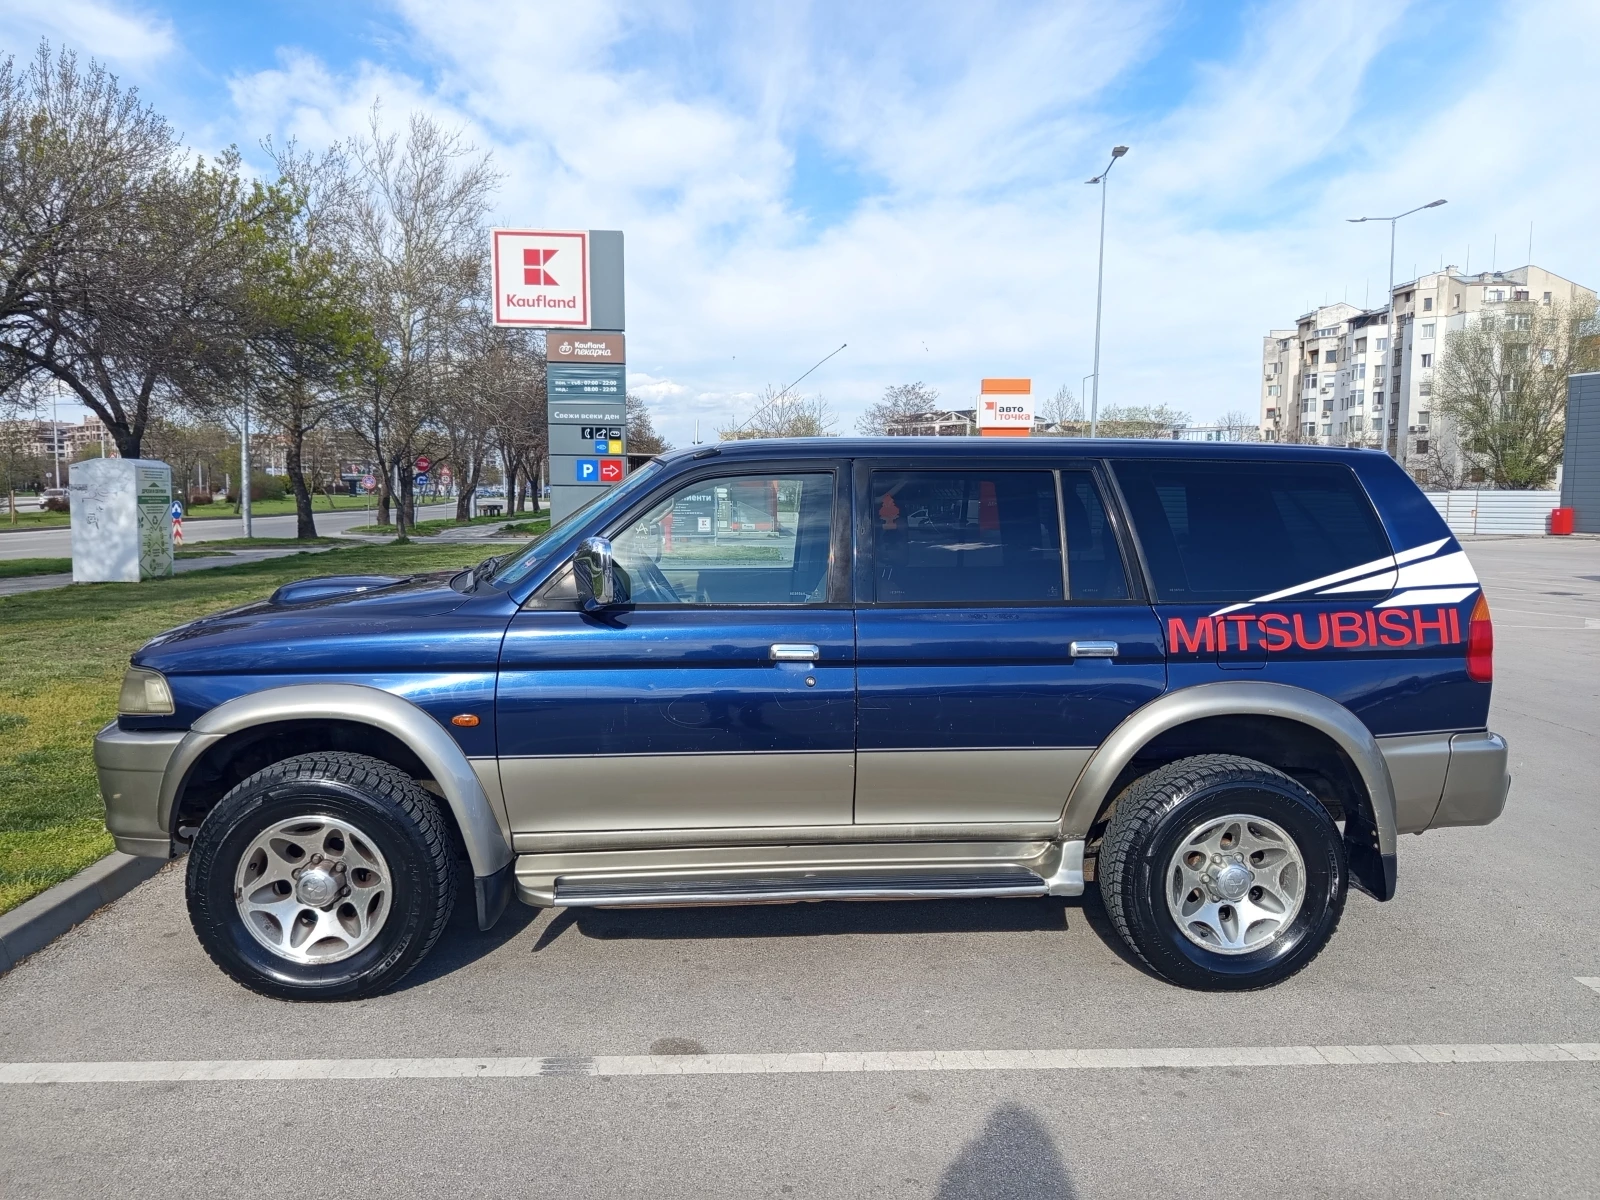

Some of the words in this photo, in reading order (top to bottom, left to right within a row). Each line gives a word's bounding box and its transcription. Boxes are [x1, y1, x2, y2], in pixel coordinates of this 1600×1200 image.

[506, 294, 576, 309] Kaufland
[574, 341, 606, 349] Kaufland
[554, 411, 580, 419] Свежи
[998, 413, 1031, 421] точка
[583, 463, 593, 477] P
[681, 494, 712, 502] иенти
[1168, 608, 1461, 653] MITSUBISHI
